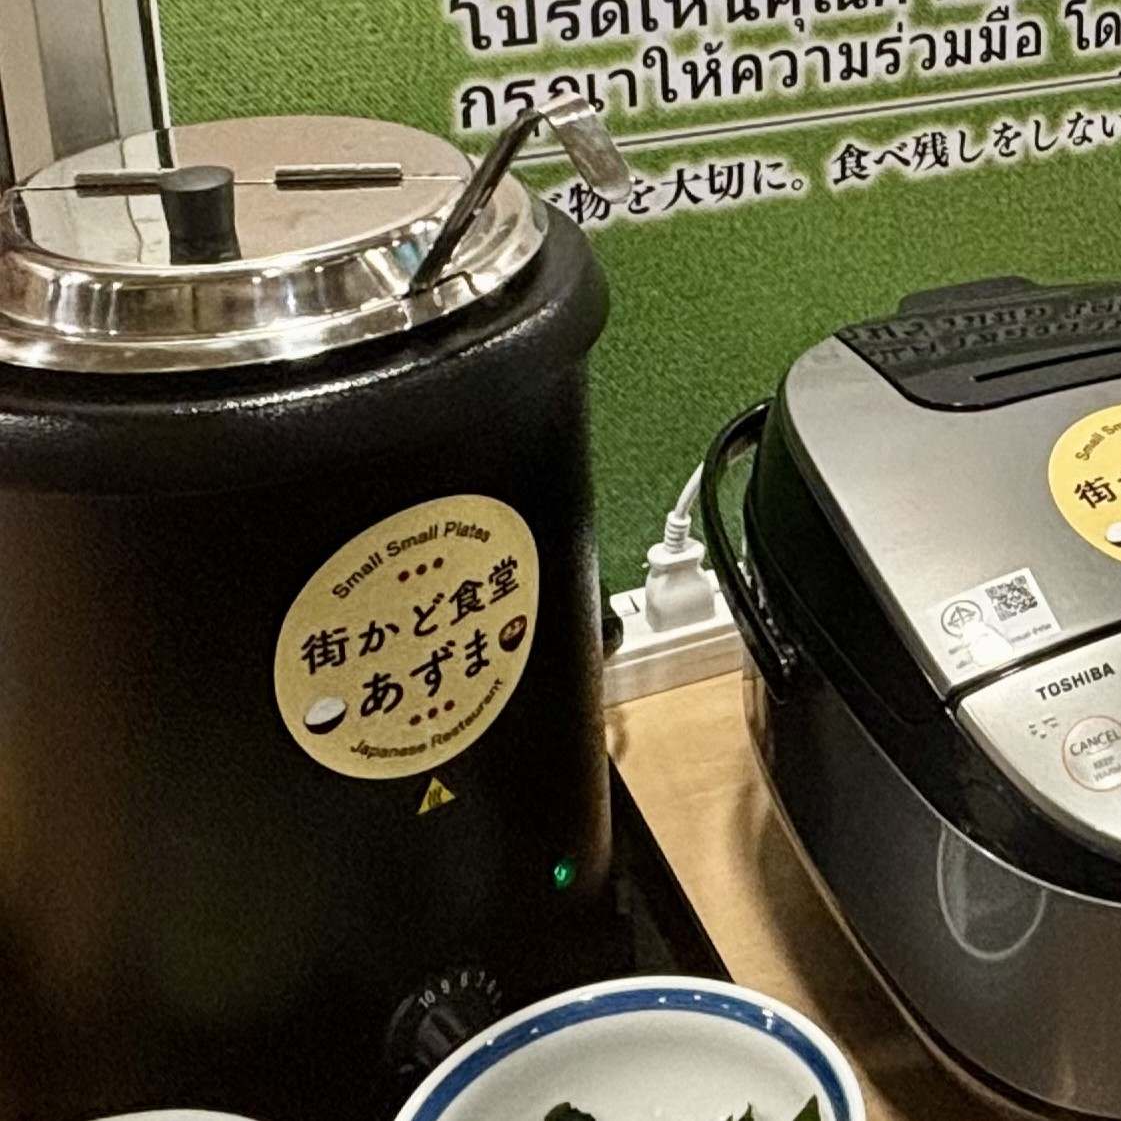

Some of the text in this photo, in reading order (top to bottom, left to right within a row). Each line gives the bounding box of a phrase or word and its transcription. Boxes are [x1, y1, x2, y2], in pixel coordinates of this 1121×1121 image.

[460, 5, 1042, 137] กรณาให้ความร่วมมือ
[1075, 433, 1105, 461] Small
[333, 521, 491, 600] Small Small Plates
[300, 556, 519, 675] 街かど食堂
[360, 629, 490, 717] あずま
[1035, 662, 1116, 701] TOSHIBA
[351, 678, 503, 759] Japanese Restaurant
[1069, 729, 1121, 756] CANCEL
